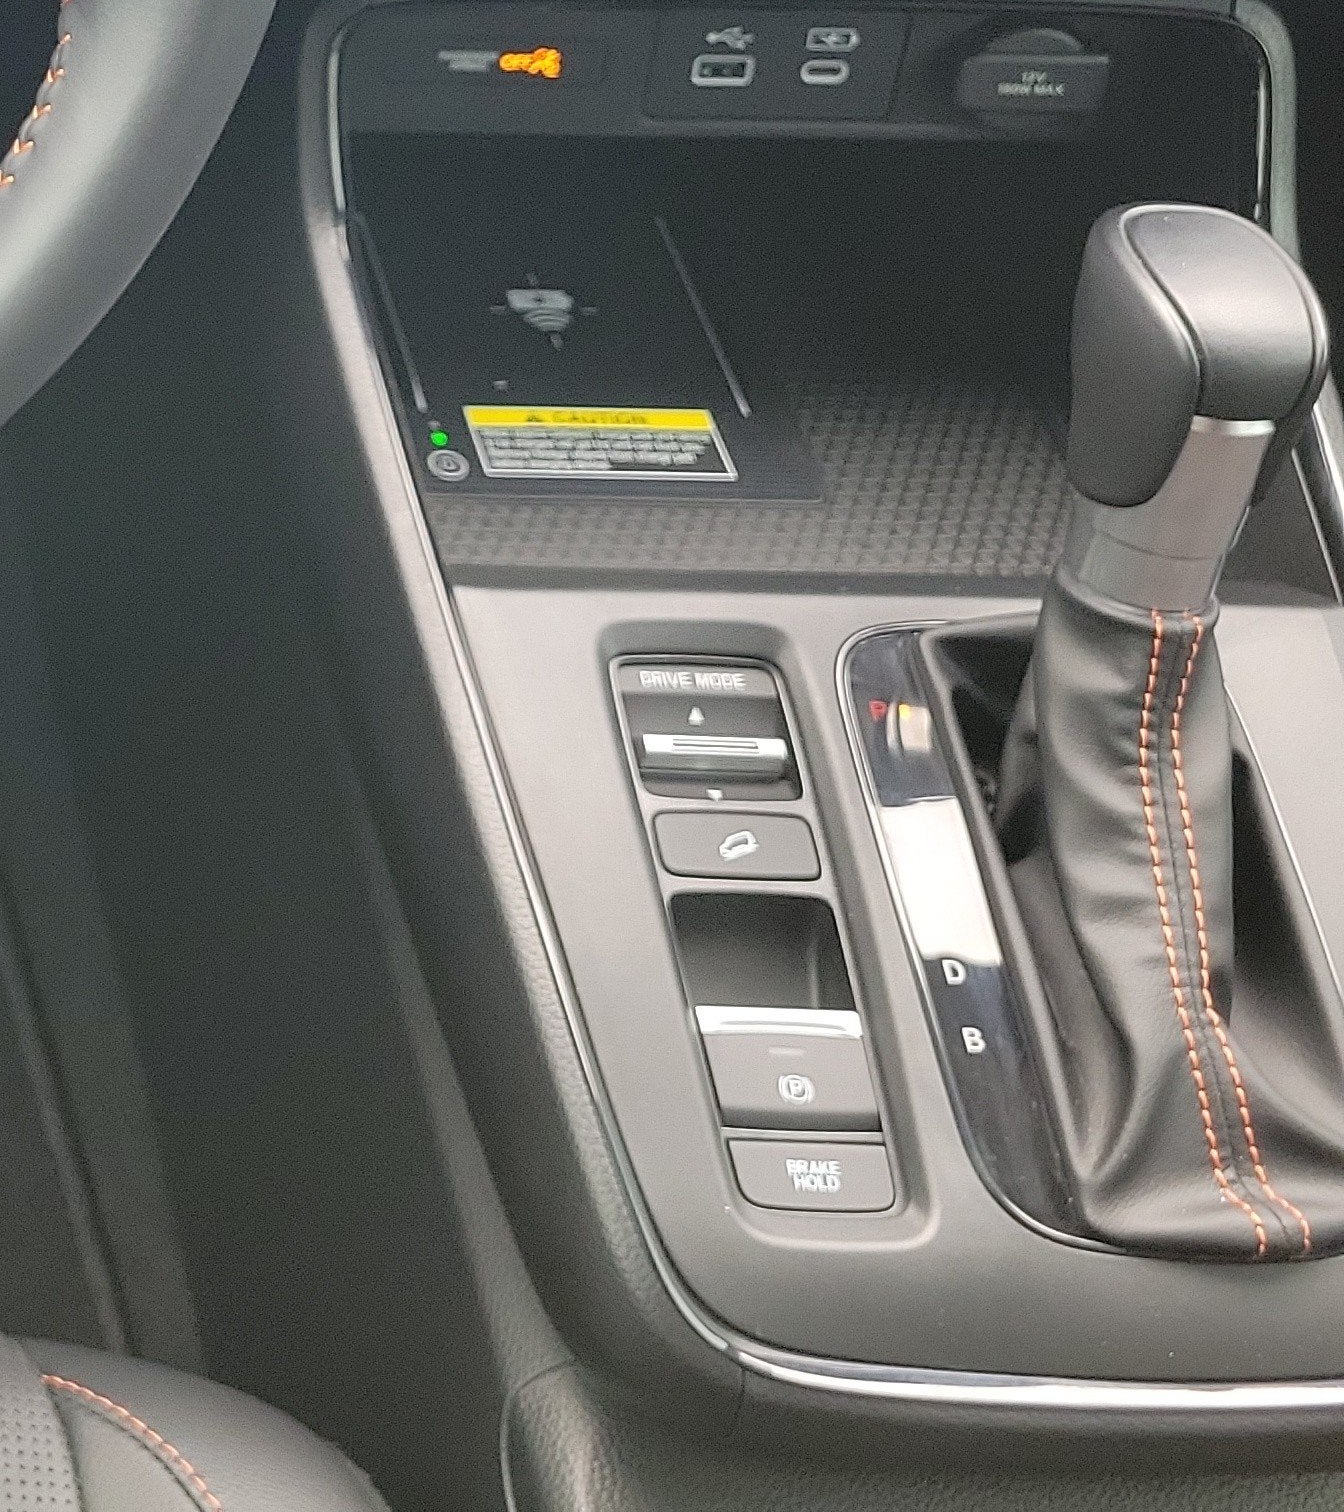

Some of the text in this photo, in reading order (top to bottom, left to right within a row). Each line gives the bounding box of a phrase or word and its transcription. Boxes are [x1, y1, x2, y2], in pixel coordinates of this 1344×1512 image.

[639, 670, 746, 689] DRIVE MODE
[941, 958, 966, 986] D
[960, 1026, 986, 1054] B
[785, 1158, 841, 1176] BRAKE
[793, 1174, 841, 1192] HOLD
